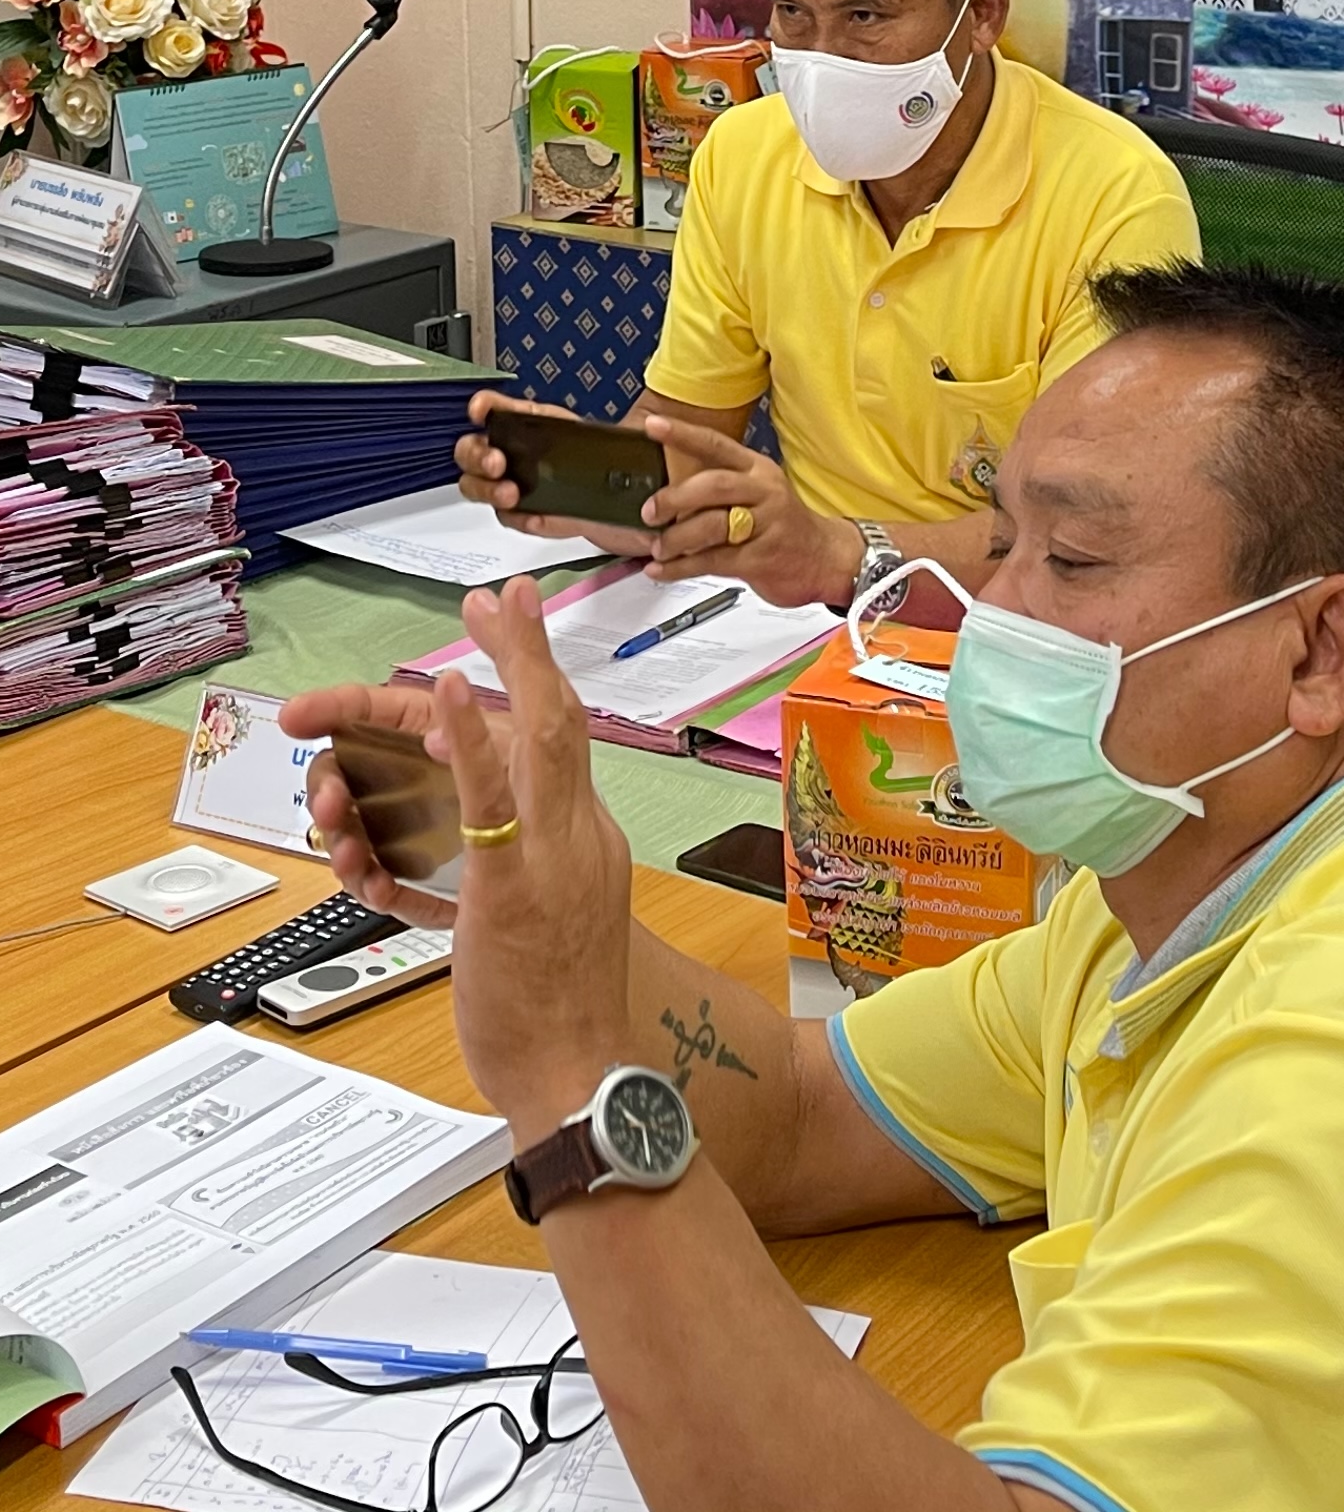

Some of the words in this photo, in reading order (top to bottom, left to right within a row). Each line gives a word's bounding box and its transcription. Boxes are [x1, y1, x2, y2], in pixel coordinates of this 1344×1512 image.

[810, 820, 1003, 870] ข้าวหอมมะลิอินทรีย์
[305, 1086, 372, 1126] CANCEL
